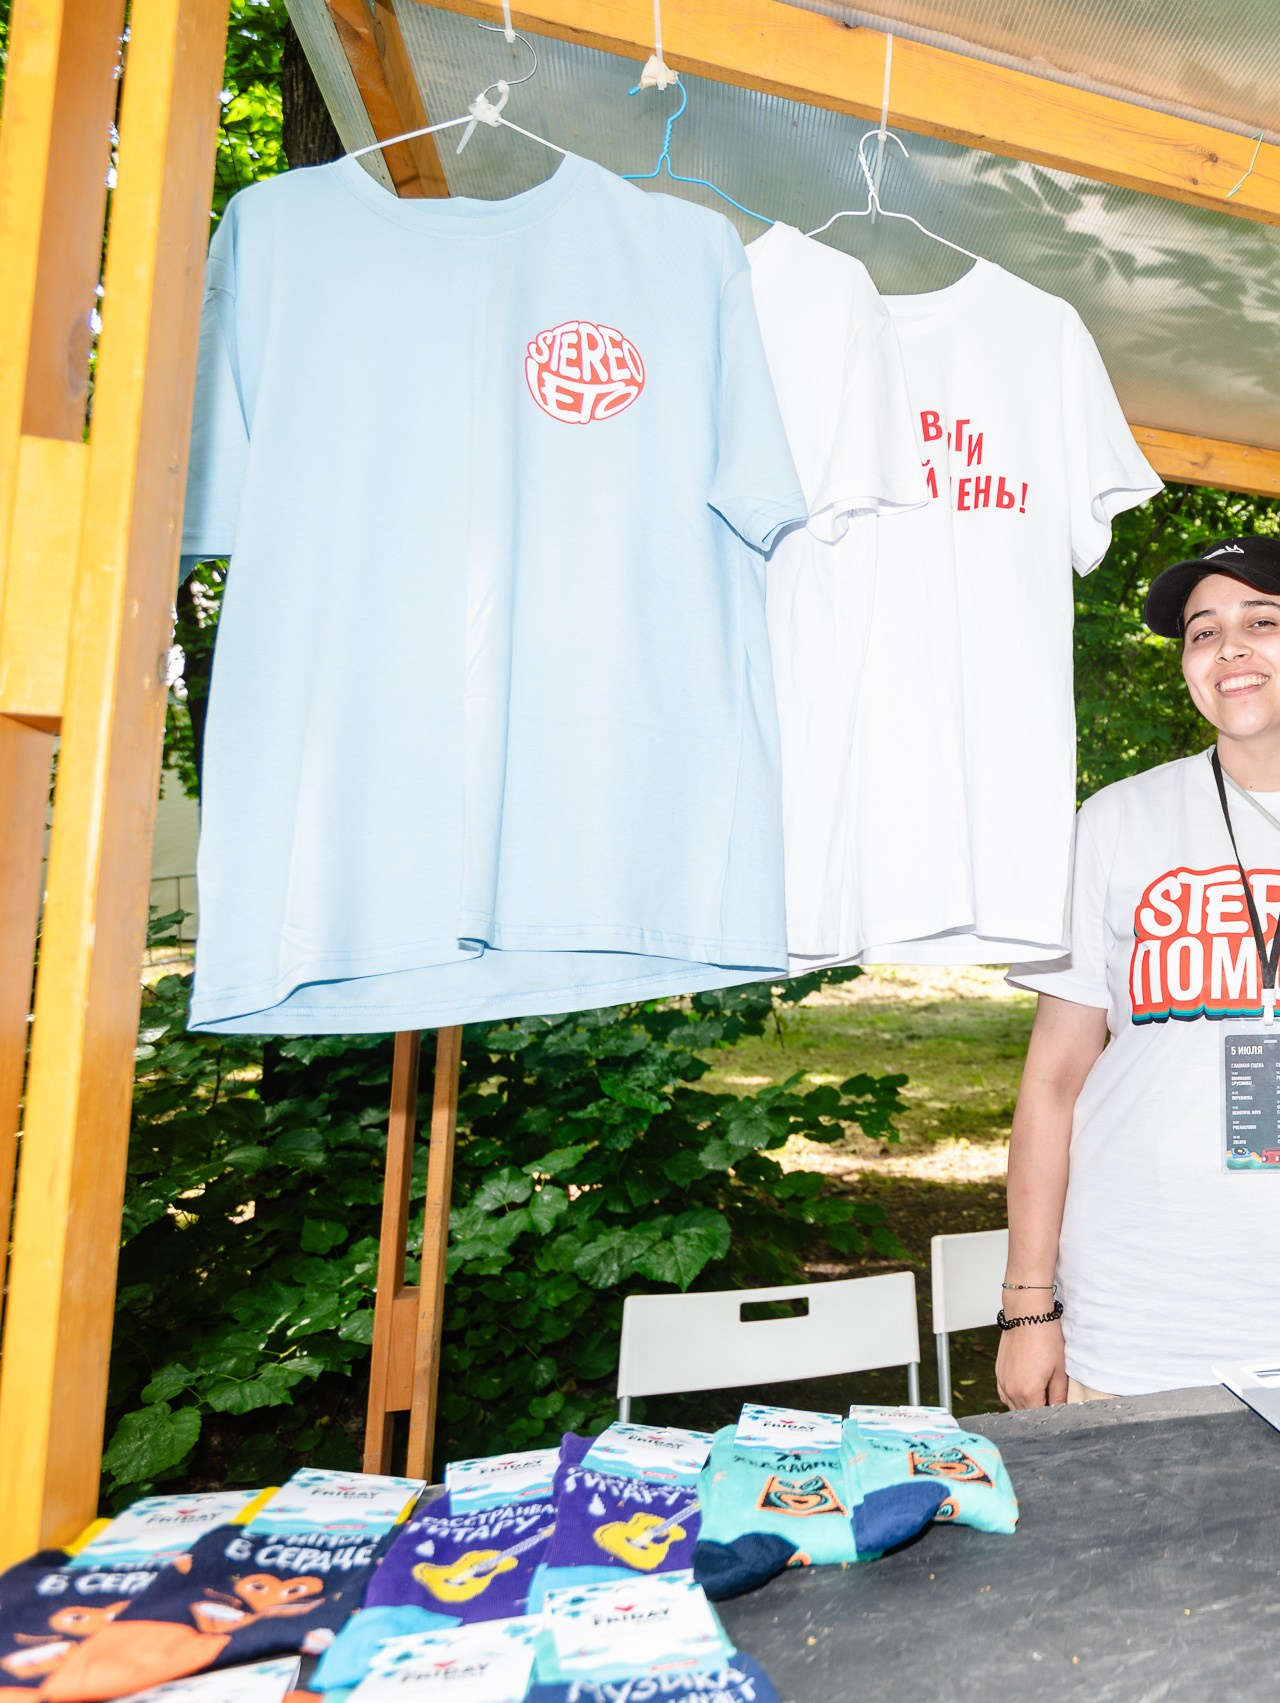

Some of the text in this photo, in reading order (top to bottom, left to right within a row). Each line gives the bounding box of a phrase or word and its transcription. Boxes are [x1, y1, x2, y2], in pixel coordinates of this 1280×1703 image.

[528, 320, 644, 383] STEREO
[526, 357, 639, 424] LETO
[949, 475, 1028, 514] ЕНЬ!
[1231, 1045, 1263, 1055] 5 ИЮЛЯ
[311, 1488, 382, 1498] FRIDAY
[145, 1511, 223, 1525] FRIDAY
[411, 1503, 559, 1529] РАССТРАИВА
[254, 1543, 378, 1574] СЕРДЦЕ
